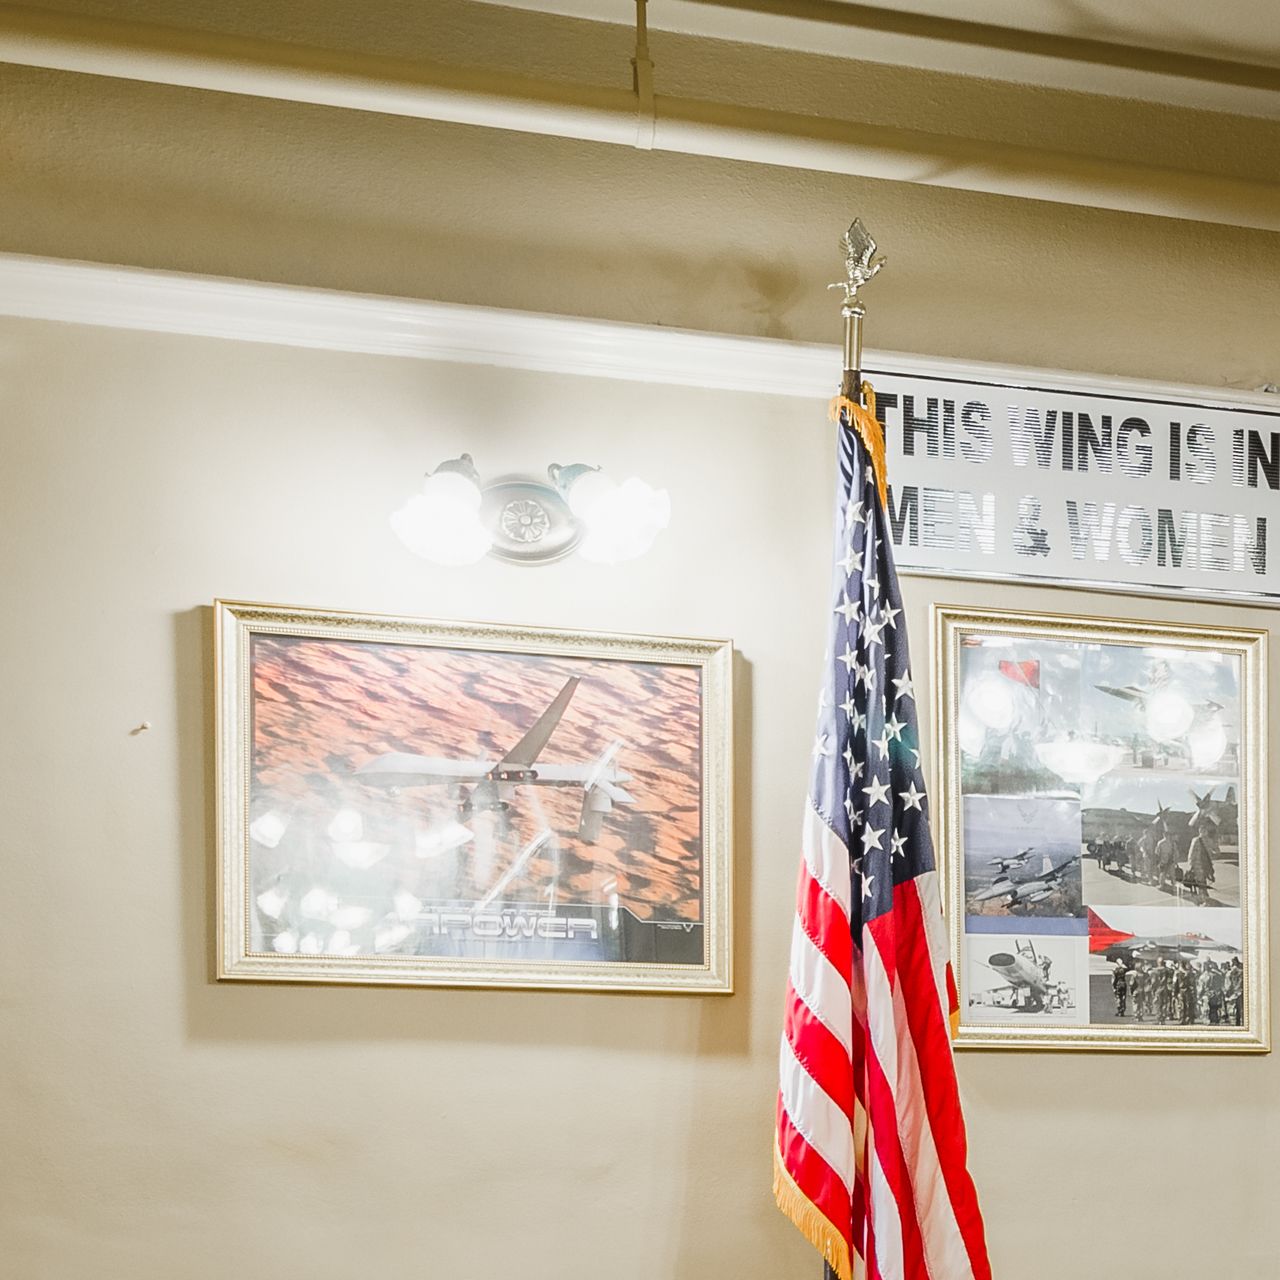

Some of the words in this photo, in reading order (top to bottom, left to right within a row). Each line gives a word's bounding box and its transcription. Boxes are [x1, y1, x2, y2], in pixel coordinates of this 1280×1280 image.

[864, 391, 994, 464] THIS
[1007, 405, 1153, 479] WING
[1169, 421, 1217, 485] IS
[1232, 429, 1280, 491] IN
[886, 484, 996, 555] MEN
[1011, 495, 1051, 558] &
[1065, 500, 1267, 575] WOMEN
